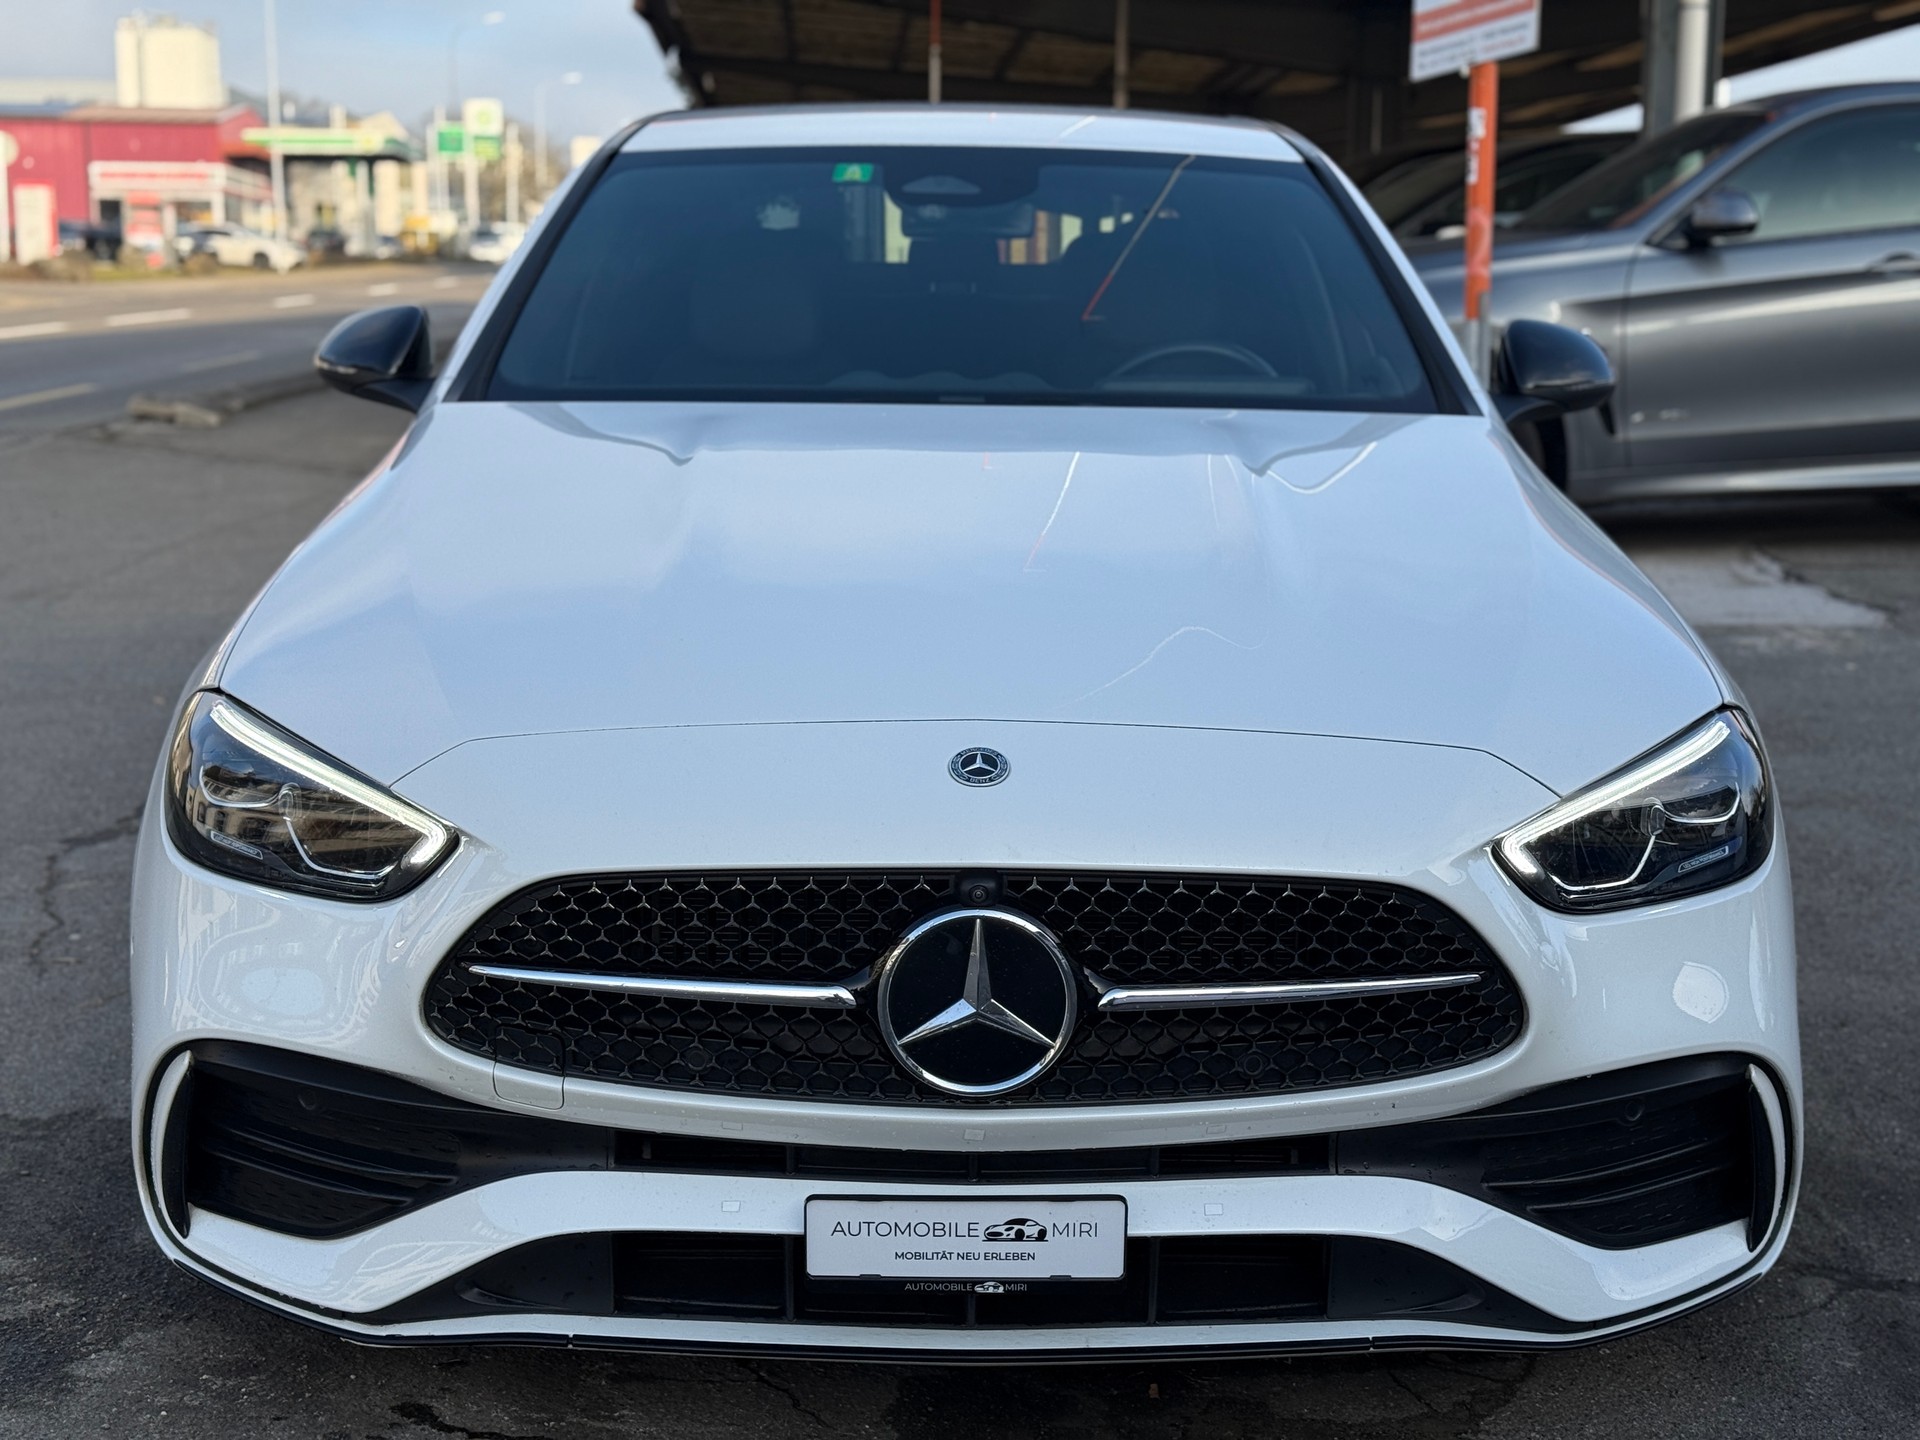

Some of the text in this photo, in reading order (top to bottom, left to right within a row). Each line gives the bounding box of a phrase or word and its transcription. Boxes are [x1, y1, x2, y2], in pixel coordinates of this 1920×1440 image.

[830, 1221, 1098, 1238] AUTOMOBILE MIRI
[894, 1250, 1036, 1261] MOBILITÄT NEU ERLEBEN
[904, 1282, 1028, 1291] AUTOMOBILE MIRI
